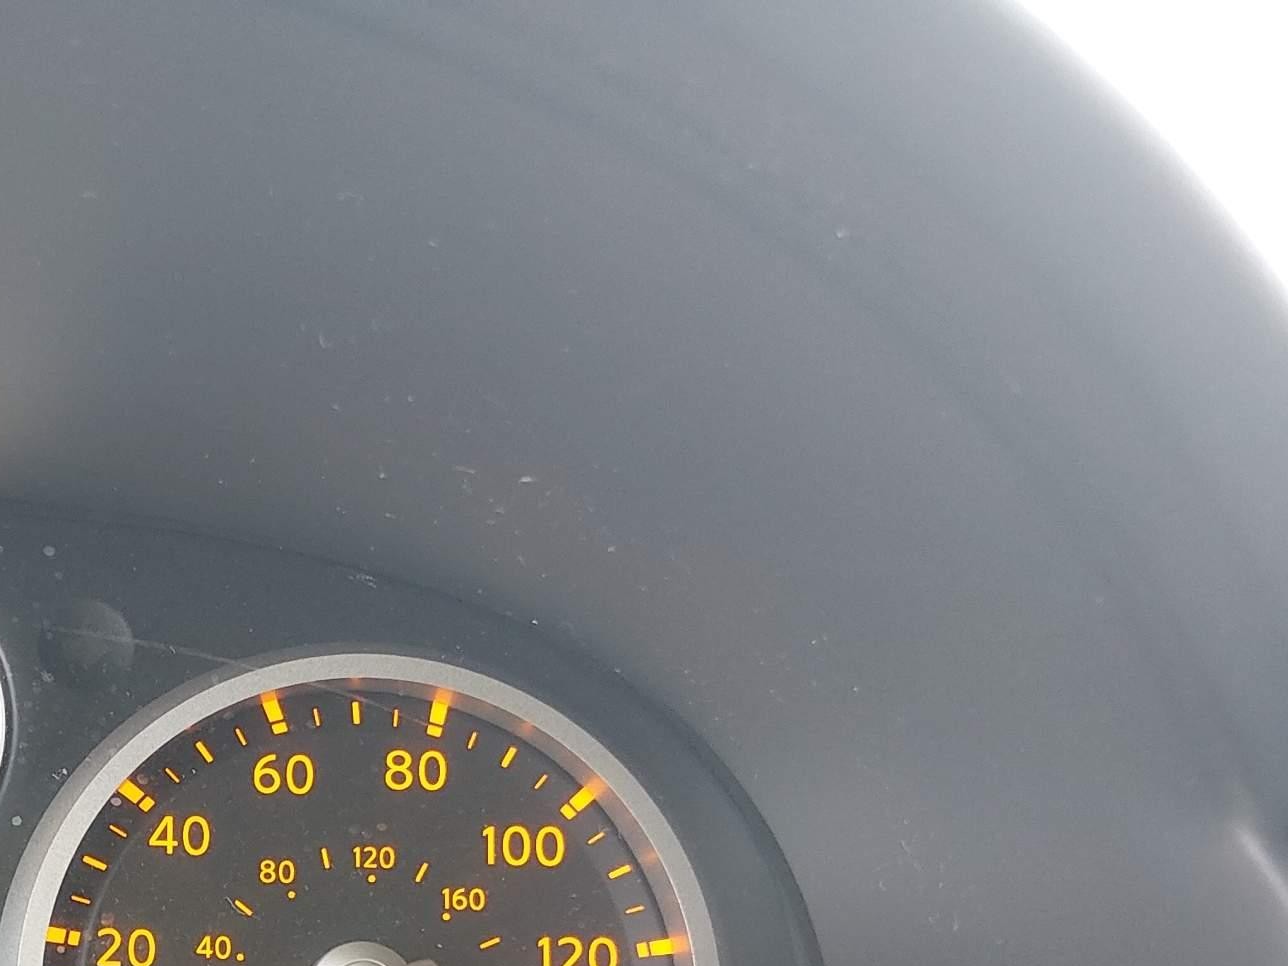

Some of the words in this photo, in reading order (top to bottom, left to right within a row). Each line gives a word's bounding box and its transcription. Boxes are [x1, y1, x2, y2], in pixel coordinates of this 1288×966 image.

[252, 754, 315, 796] 60
[384, 750, 448, 792] 80
[149, 815, 212, 857] 40
[481, 824, 565, 868] 100
[258, 859, 296, 885] 80
[351, 845, 396, 871] 120
[441, 887, 486, 912] 160
[195, 935, 232, 960] 40
